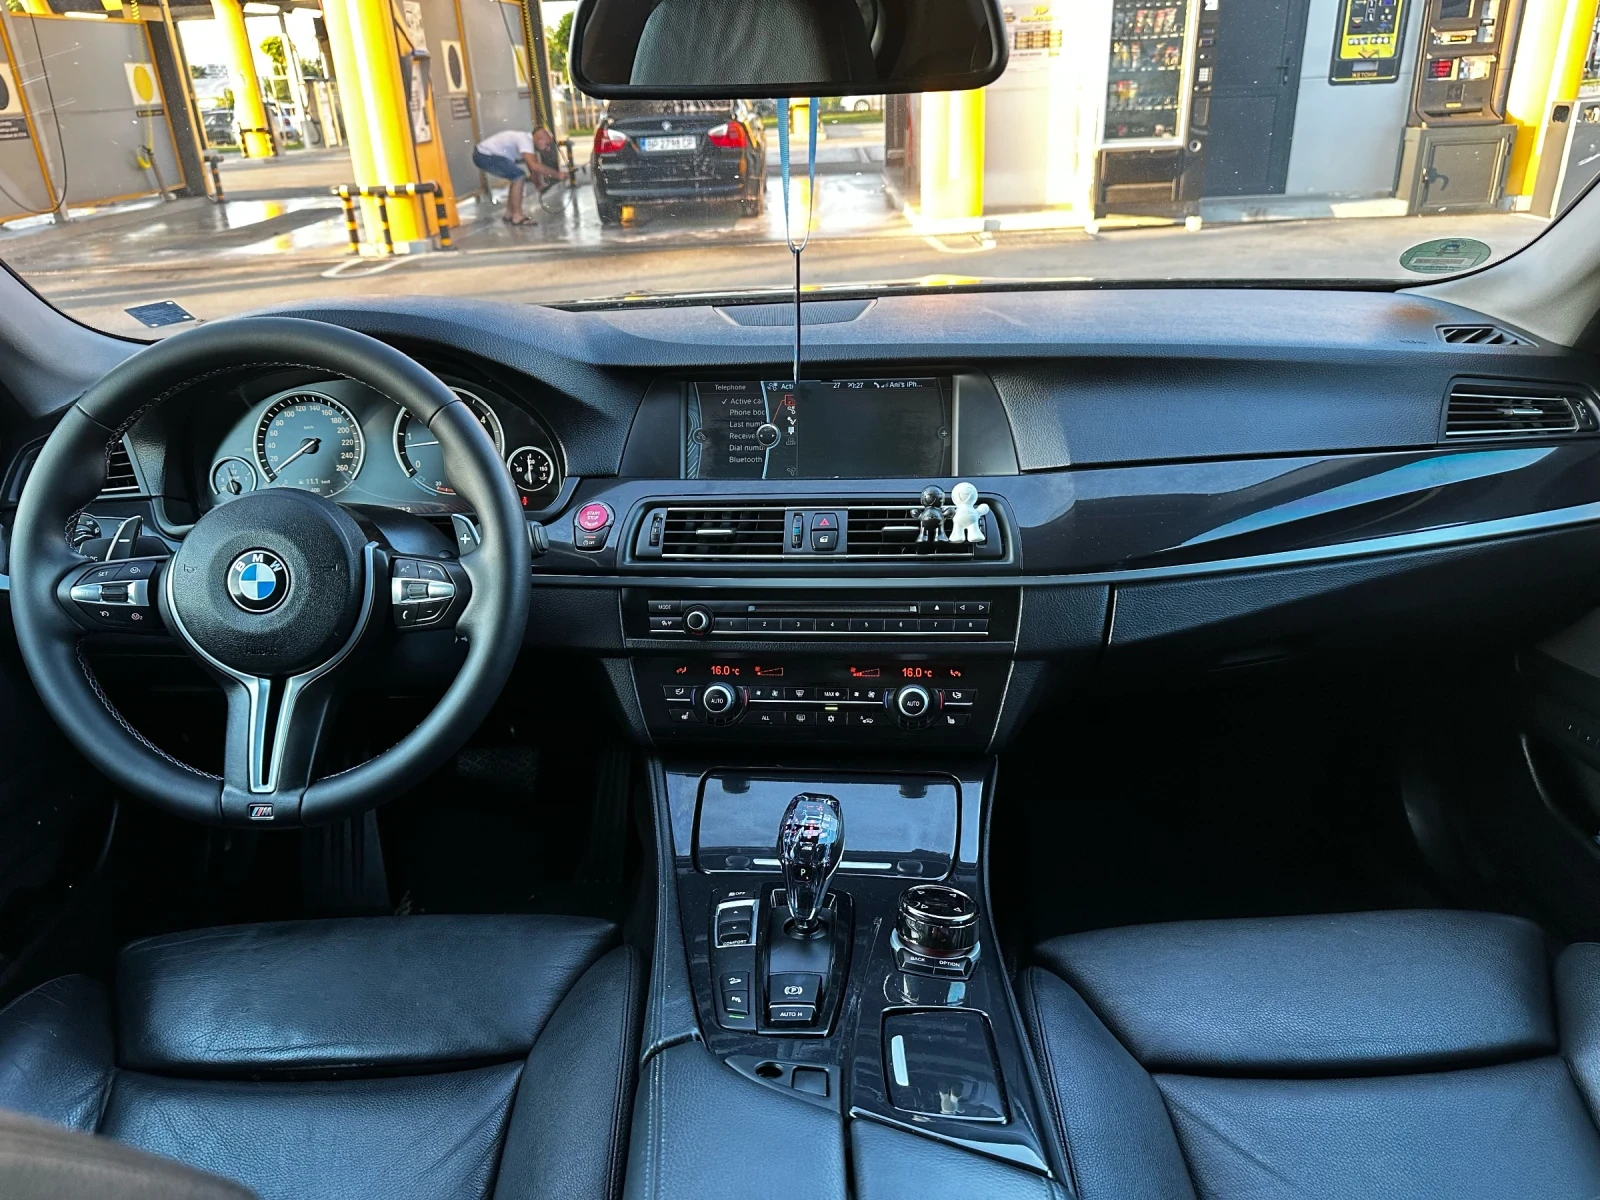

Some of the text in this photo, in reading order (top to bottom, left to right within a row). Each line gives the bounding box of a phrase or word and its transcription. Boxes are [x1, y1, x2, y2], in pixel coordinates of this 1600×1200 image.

[480, 416, 486, 424] 4
[407, 432, 412, 441] 1
[234, 554, 282, 572] BMW
[710, 666, 730, 675] 16.0
[902, 668, 922, 677] 16.0
